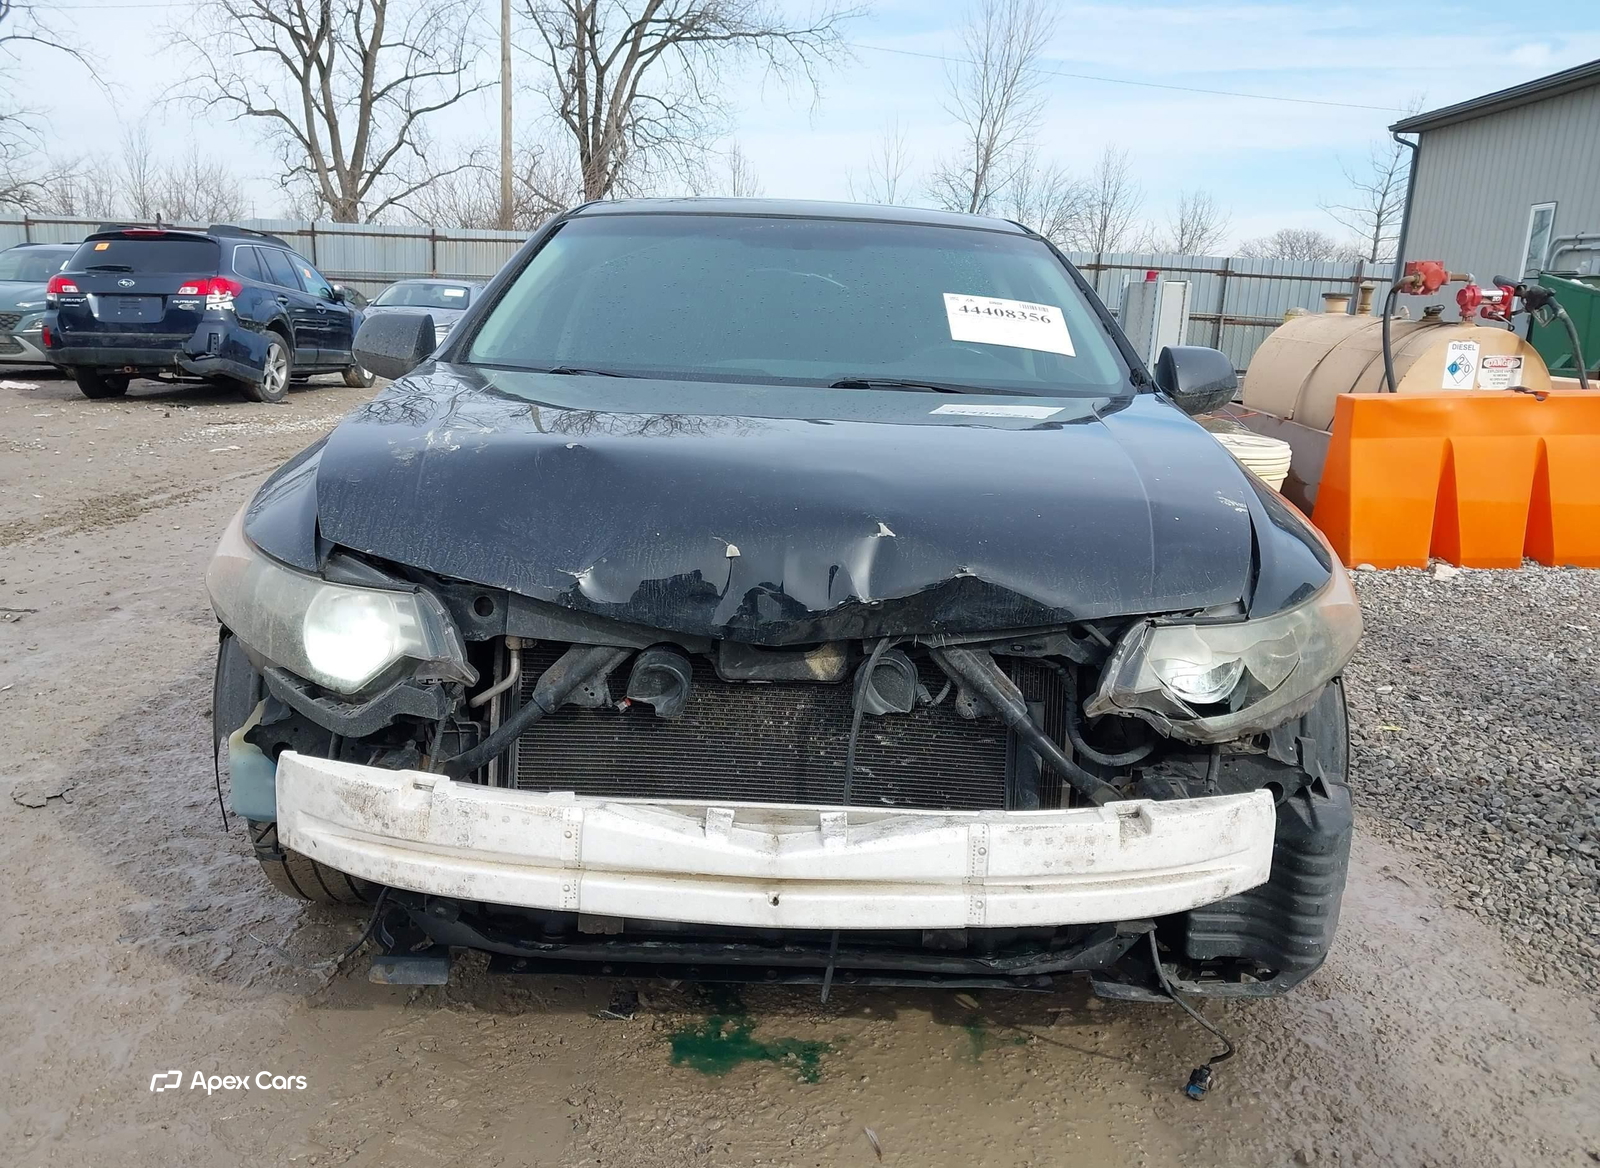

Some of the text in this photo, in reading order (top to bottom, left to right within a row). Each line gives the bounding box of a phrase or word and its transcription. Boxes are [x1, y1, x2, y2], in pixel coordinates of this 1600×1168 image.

[958, 304, 1051, 324] 44408356
[1452, 343, 1476, 351] DIESEL
[1459, 356, 1465, 366] 2
[1451, 363, 1458, 373] 0
[1464, 364, 1470, 374] 0
